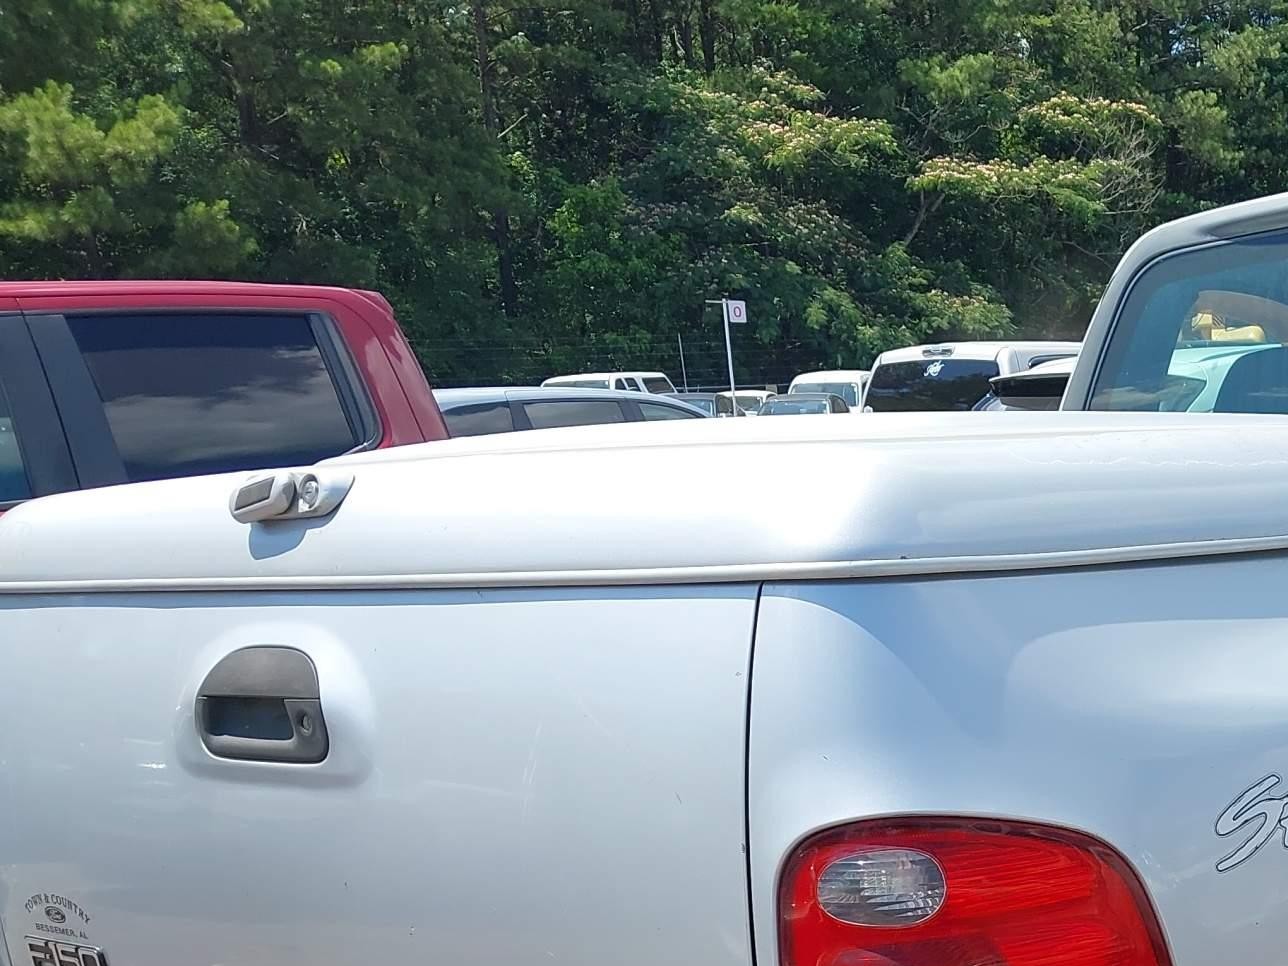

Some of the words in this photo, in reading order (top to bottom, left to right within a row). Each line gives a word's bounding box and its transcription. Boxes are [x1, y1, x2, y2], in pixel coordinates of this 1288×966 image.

[25, 893, 44, 913] TOWN
[44, 893, 50, 904] &
[51, 894, 90, 925] COUNTRY
